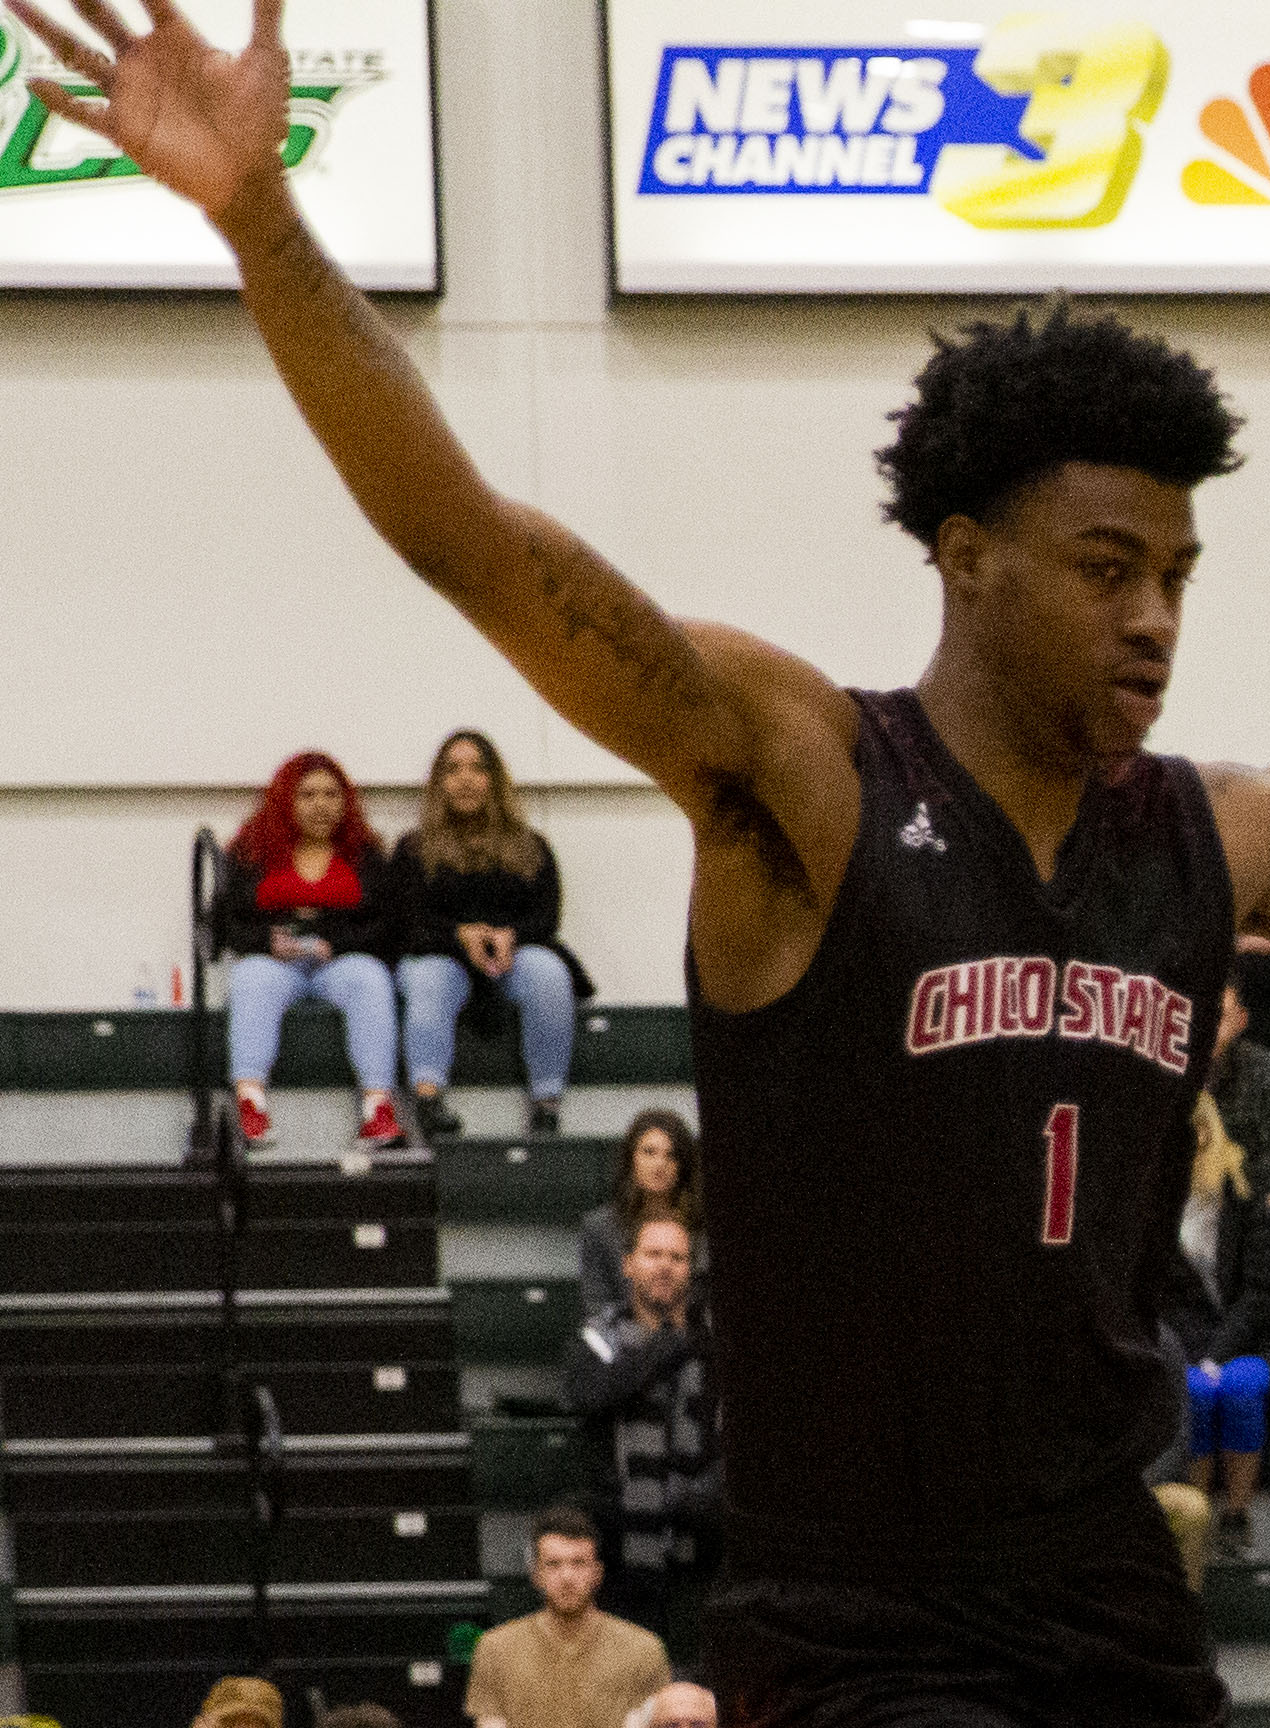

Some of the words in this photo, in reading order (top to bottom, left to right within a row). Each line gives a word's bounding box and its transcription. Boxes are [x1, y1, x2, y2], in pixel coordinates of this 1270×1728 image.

[665, 56, 947, 134] NEWS
[653, 133, 925, 187] CHANNEL
[1058, 959, 1193, 1075] STATE
[1042, 1104, 1079, 1244] 1
